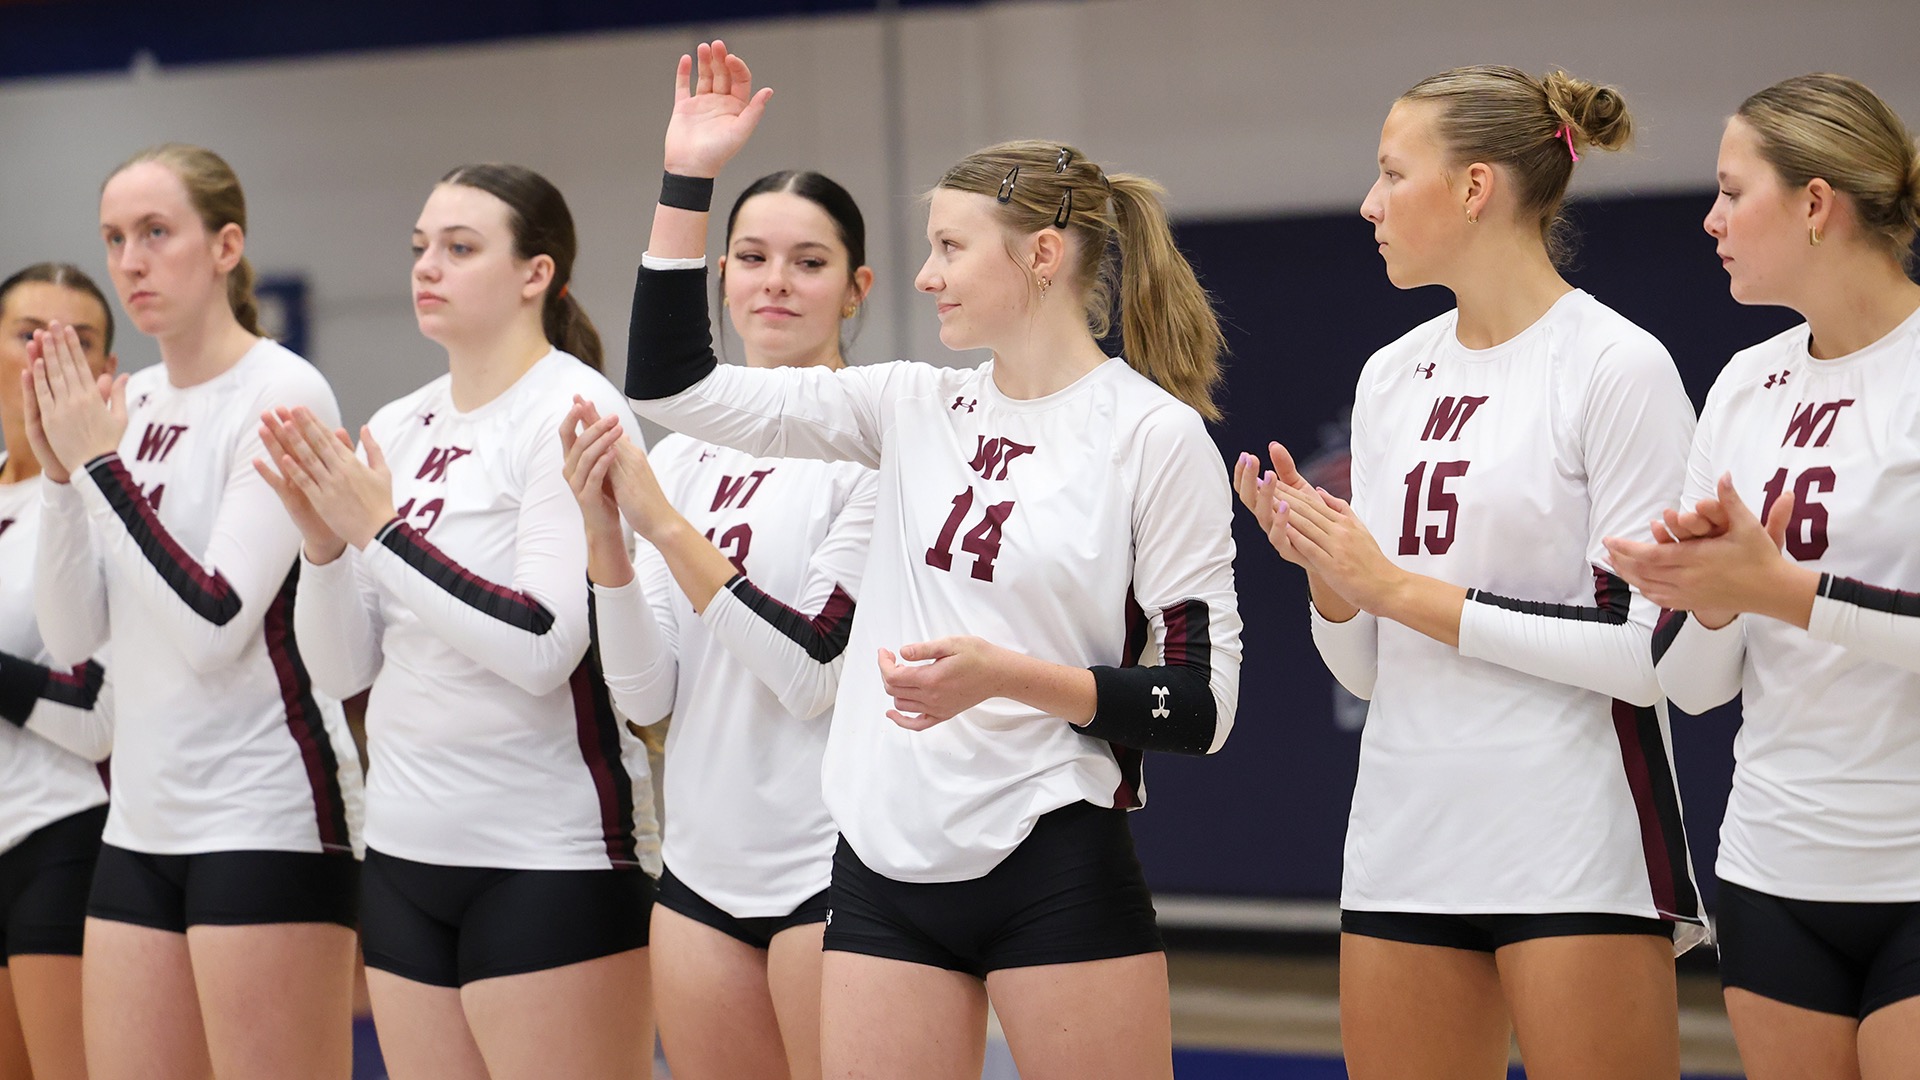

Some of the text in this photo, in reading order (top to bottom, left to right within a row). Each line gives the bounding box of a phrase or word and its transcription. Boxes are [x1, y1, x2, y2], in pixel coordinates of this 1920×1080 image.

[136, 422, 188, 462] WT
[1420, 395, 1489, 442] WT
[1781, 398, 1855, 448] WT
[415, 446, 472, 483] WT
[968, 434, 1036, 481] WT
[709, 467, 776, 513] WT
[1398, 460, 1471, 556] 15
[1761, 465, 1837, 562] 16
[704, 523, 753, 578] 3
[925, 485, 1015, 583] 14
